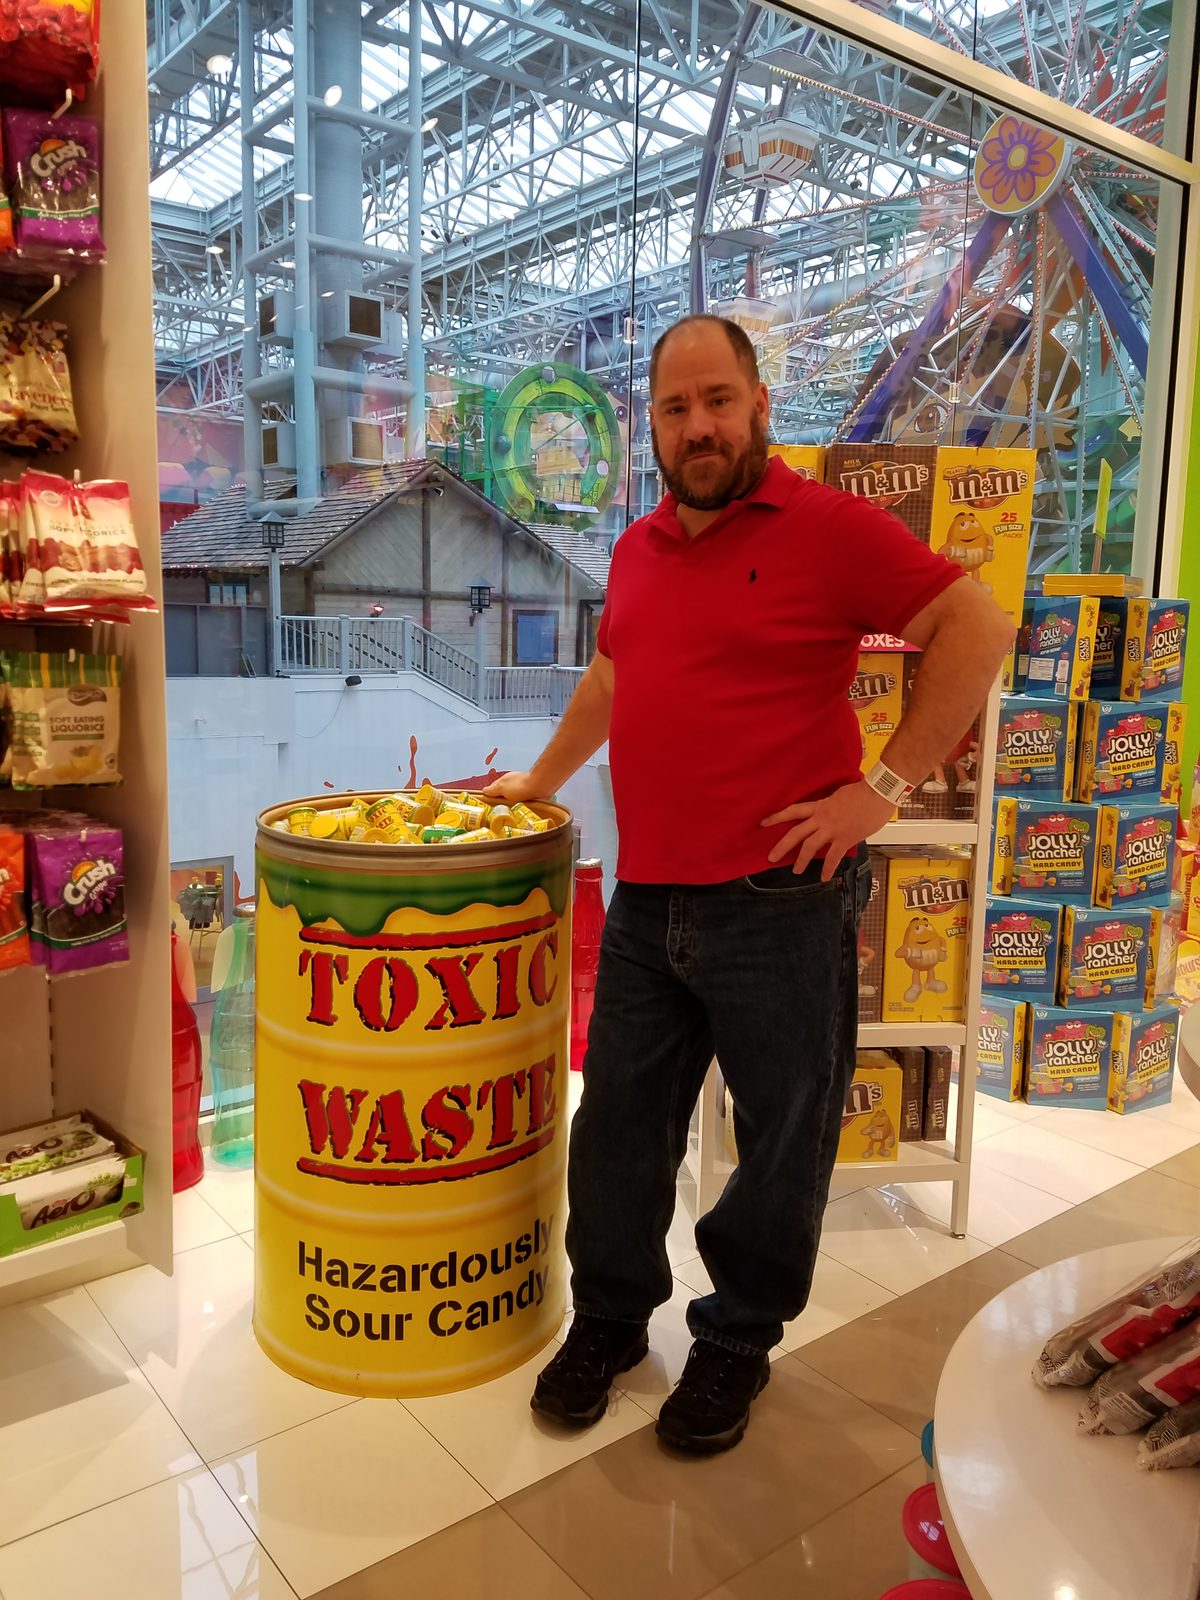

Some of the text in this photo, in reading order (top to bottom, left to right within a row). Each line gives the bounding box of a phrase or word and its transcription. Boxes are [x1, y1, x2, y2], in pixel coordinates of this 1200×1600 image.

[31, 140, 87, 177] Crush
[1001, 512, 1018, 522] 25
[860, 634, 906, 648] OXES
[1039, 626, 1061, 641] JOLLY
[1152, 628, 1179, 650] JOLLY
[1153, 642, 1180, 659] rancher
[871, 713, 888, 722] 25
[51, 724, 104, 733] LIQUORICE
[866, 724, 878, 733] FUN
[1005, 730, 1051, 748] JOLLY
[1108, 733, 1152, 754] JOLLY
[1007, 743, 1054, 756] rancher
[1110, 746, 1155, 762] rancher
[1009, 755, 1054, 765] HARD CANDY
[1112, 760, 1154, 772] HARD CANDY
[1029, 834, 1078, 851] JOLLY
[1126, 834, 1164, 858] JOLLY
[1031, 848, 1082, 859] rancher
[1128, 849, 1167, 867] rancher
[1129, 868, 1145, 876] HARD
[1146, 862, 1165, 872] CANDY
[64, 859, 116, 905] Crush
[952, 916, 968, 926] 25
[992, 932, 1040, 947] JOLLY
[994, 944, 1045, 957] rancher
[1085, 940, 1132, 960] JOLLY
[1087, 954, 1136, 969] rancher
[1089, 967, 1135, 978] HARD CANDY
[298, 931, 559, 1032] TOXIC
[1046, 1041, 1095, 1057] JOLLY
[1137, 1036, 1169, 1064] JOLLY
[1049, 1053, 1098, 1065] rancher
[1138, 1050, 1170, 1072] rancher
[1138, 1063, 1169, 1080] HARD CANDY
[298, 1054, 557, 1163] WASTE
[6, 1138, 63, 1163] Aero
[30, 1190, 96, 1230] Aero
[298, 1214, 554, 1293] Hazardously
[304, 1264, 550, 1341] Sour Candy
